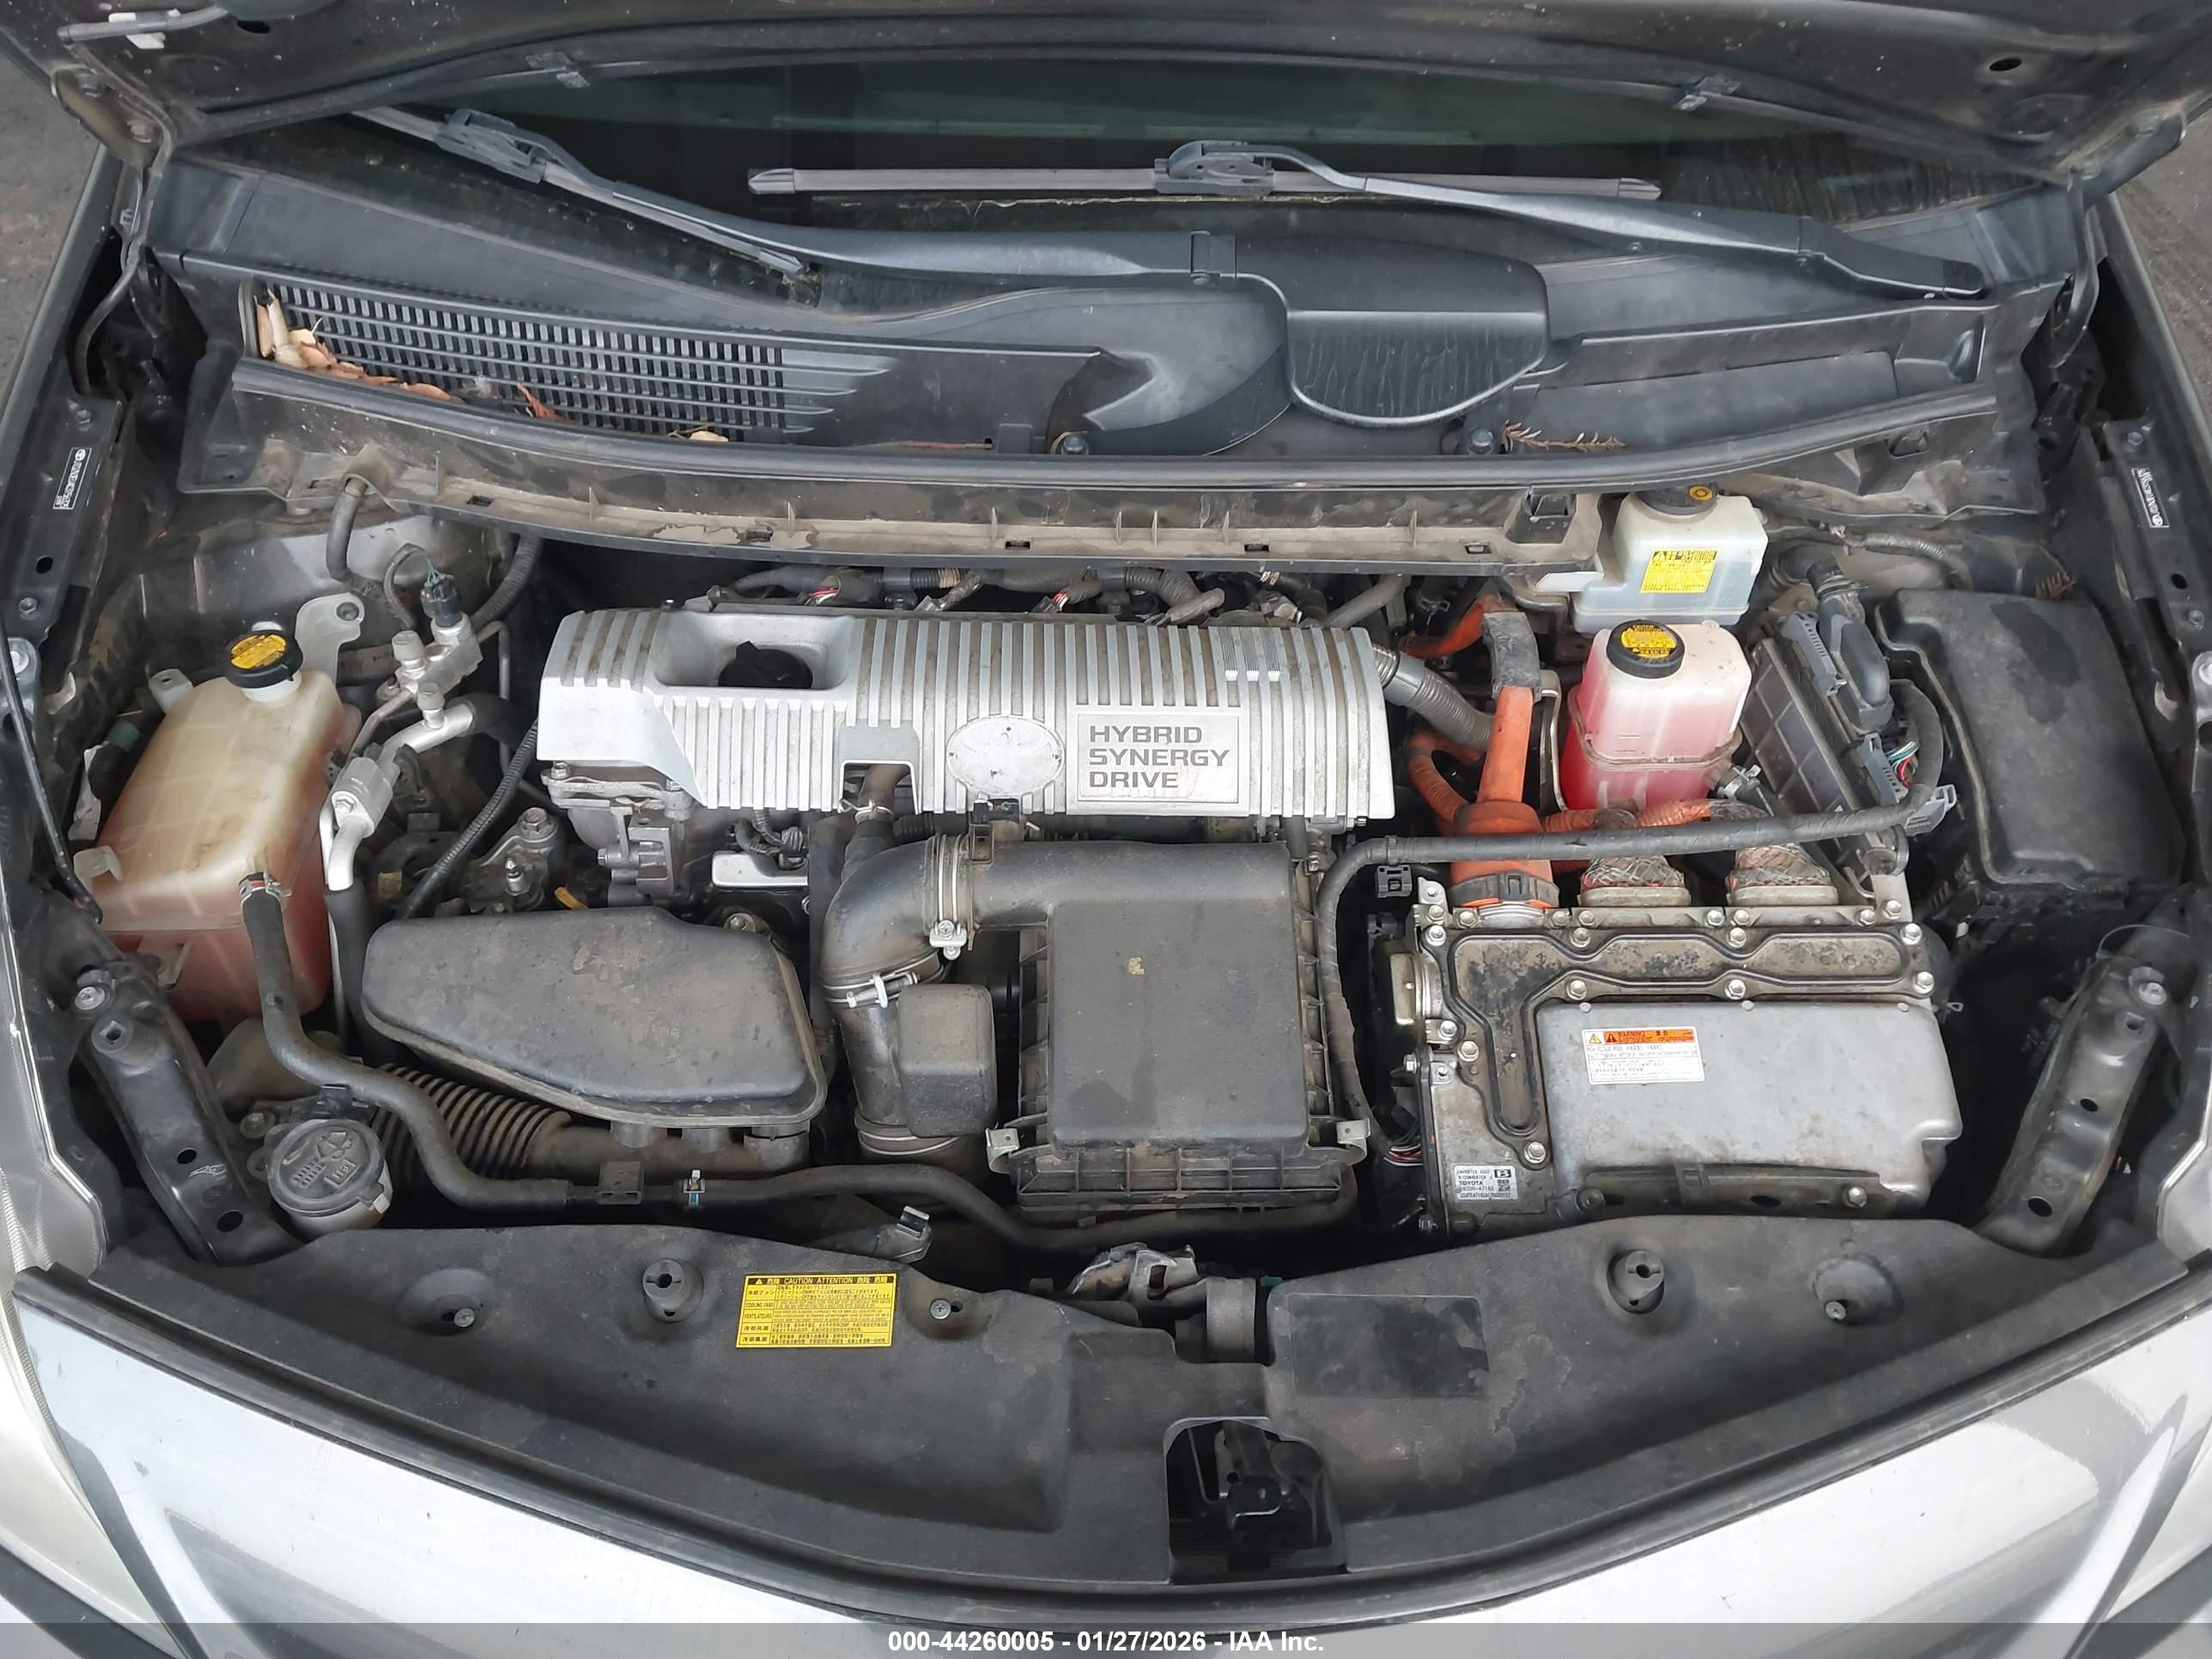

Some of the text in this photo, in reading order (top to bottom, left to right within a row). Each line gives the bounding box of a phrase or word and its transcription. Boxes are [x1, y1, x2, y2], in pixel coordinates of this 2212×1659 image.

[1090, 726, 1202, 744] HYBRID
[1089, 748, 1230, 766] SYNERGY
[1089, 771, 1179, 788] DRIVE
